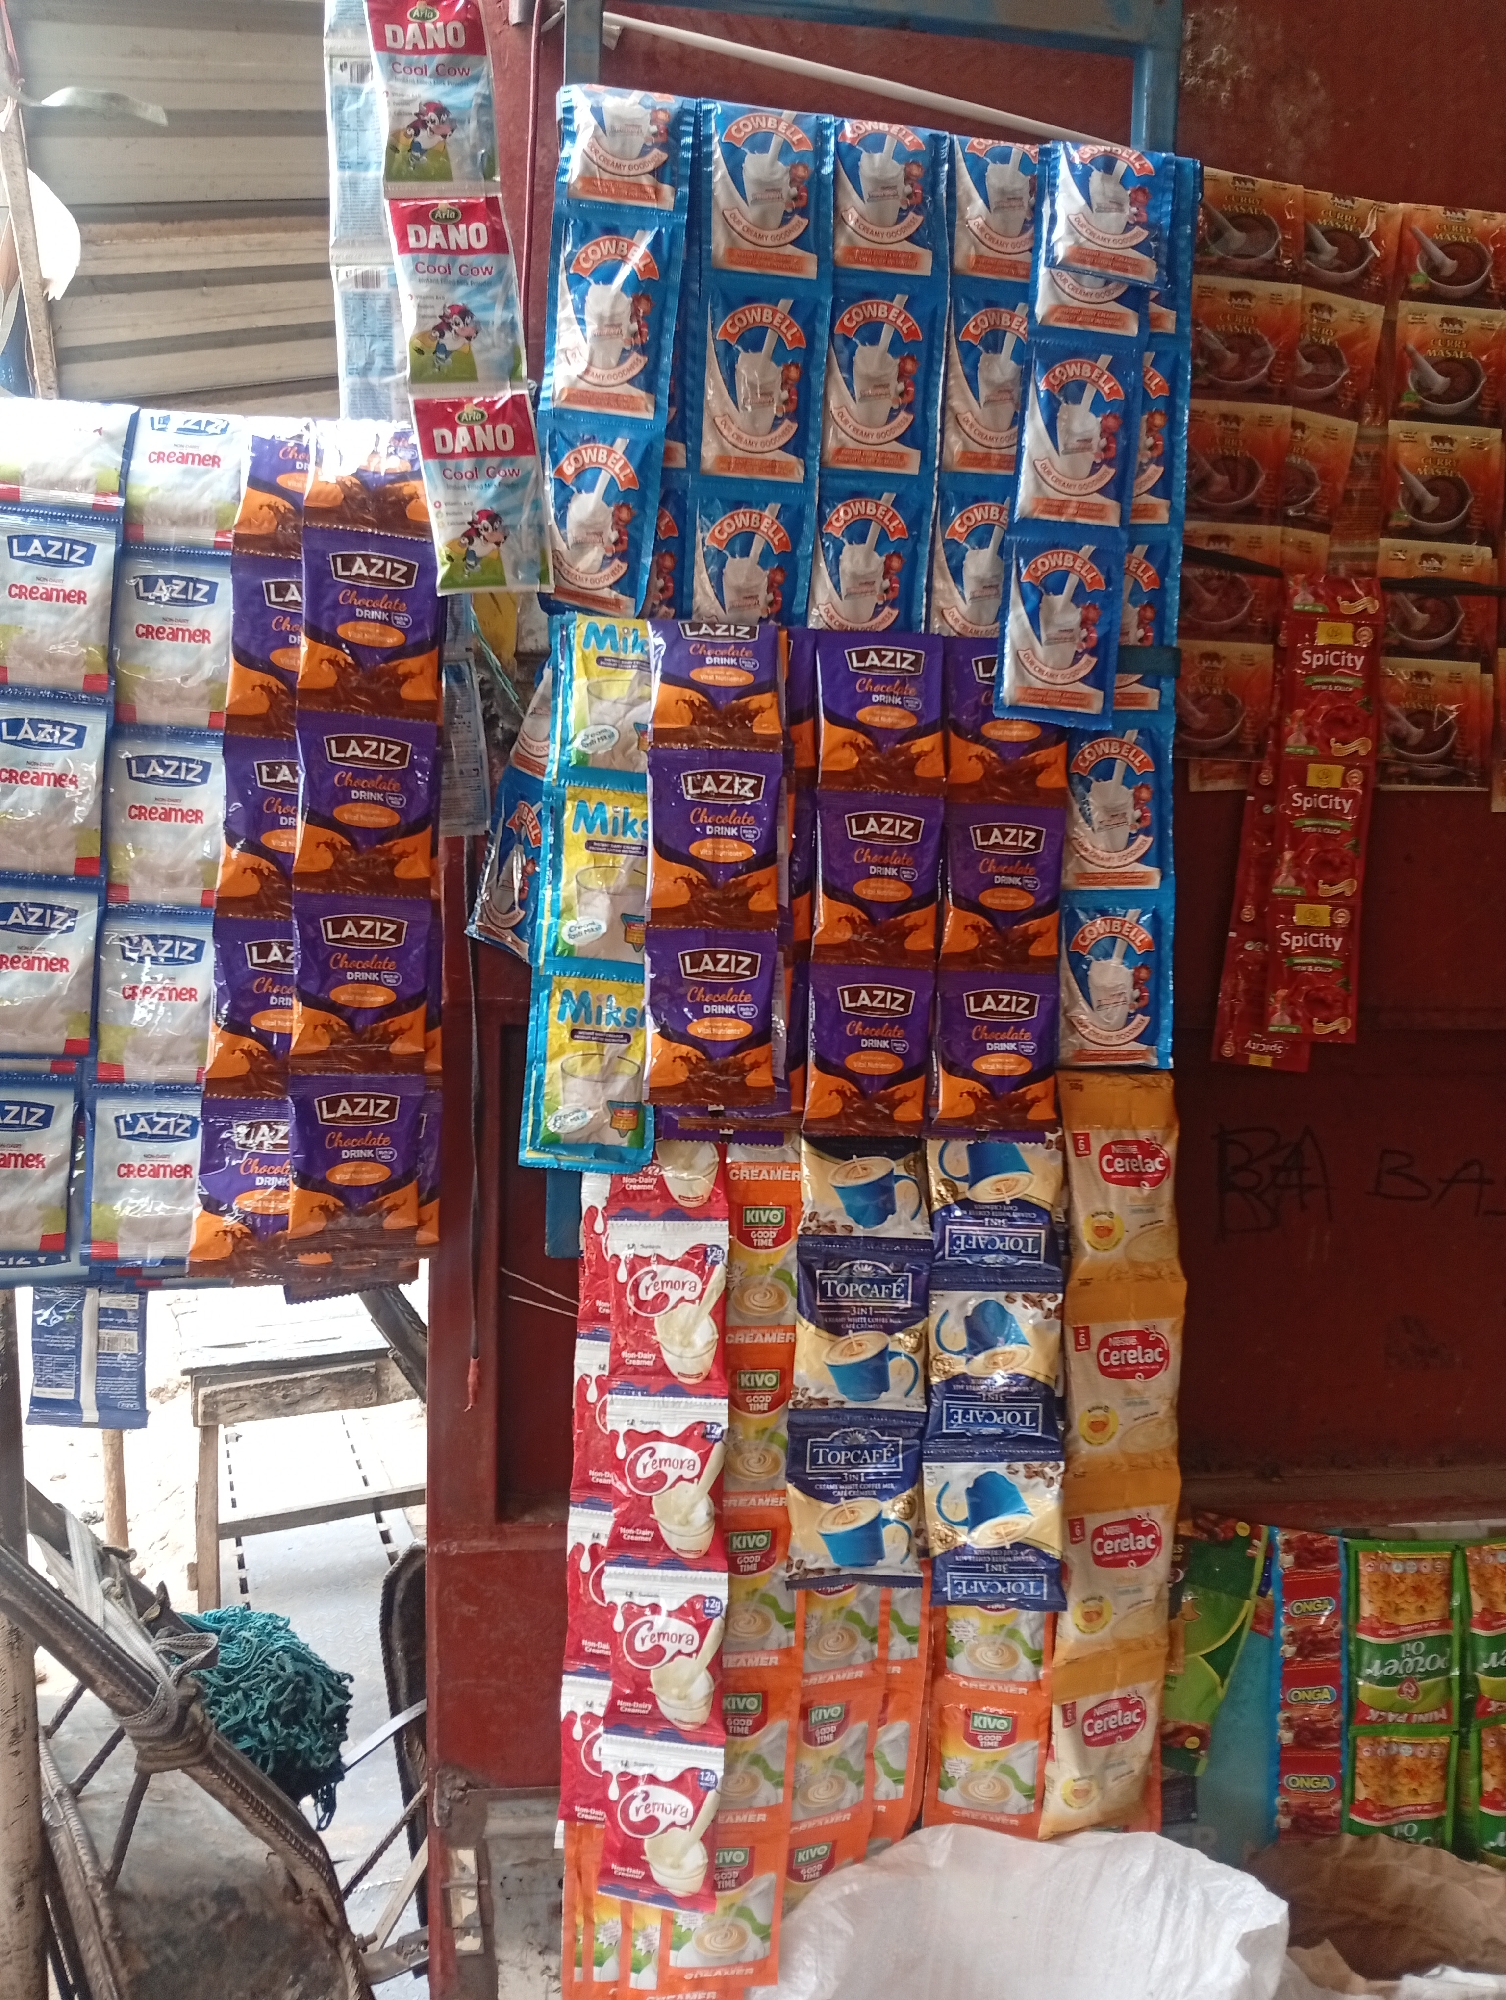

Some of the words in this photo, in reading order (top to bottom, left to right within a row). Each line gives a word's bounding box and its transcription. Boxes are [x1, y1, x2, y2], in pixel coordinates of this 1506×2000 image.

[412, 9, 434, 19] Arla
[384, 21, 466, 50] DANO
[391, 61, 428, 77] Cool
[435, 63, 471, 77] Cow
[730, 115, 804, 146] COWBELL
[598, 153, 627, 171] CREAMY
[1224, 196, 1263, 206] CURRY
[434, 210, 456, 220] Arla
[1320, 209, 1360, 224] CURRY
[1317, 217, 1365, 232] MASALA
[1435, 223, 1474, 234] CURRY
[406, 222, 489, 250] DANO
[1431, 232, 1479, 244] MASALA
[414, 261, 451, 275] Cool
[458, 264, 494, 277] Cow
[1056, 271, 1069, 285] OUR
[1068, 283, 1094, 299] CREAMY
[725, 305, 800, 342] COWBELL
[969, 311, 1027, 335] COWBEL
[1215, 324, 1261, 335] MASALA
[1430, 338, 1468, 349] CURRY
[1425, 349, 1474, 360] MASALA
[607, 357, 642, 381] GOODNESS
[1048, 363, 1116, 394] COWBELL
[461, 412, 482, 422] Arla
[837, 411, 849, 427] OUR
[876, 416, 909, 439] GOODNESS
[432, 424, 515, 454] DANO
[731, 432, 759, 449] CREAMY
[761, 424, 793, 449] GOODNESS
[563, 449, 631, 482] COWBELL
[1420, 456, 1460, 467] CURRY
[442, 467, 479, 481] Cool
[486, 466, 521, 479] Cow
[1417, 465, 1463, 477] MASALA
[1050, 475, 1078, 491] CREAMY
[831, 501, 899, 534] COWBELL
[954, 506, 1009, 534] COWBE
[714, 511, 785, 546] COWBELL
[12, 538, 88, 564] LAZIZ
[336, 557, 409, 584] LAZIZ
[1029, 552, 1097, 584] COWBELL
[36, 576, 64, 584] NON-DAIRY
[338, 589, 408, 611] Chocolate
[356, 608, 389, 622] DRINK
[684, 621, 750, 640] LAZIZ
[689, 644, 753, 658] Chocolate
[705, 657, 738, 666] DRINK
[851, 652, 916, 671] LAZIZ
[1023, 654, 1035, 667] OUR
[1301, 649, 1365, 670] SpiCity
[856, 678, 917, 695] Chocolate
[872, 694, 902, 705] DRINK
[1, 720, 78, 747] LAZIZ
[1077, 742, 1147, 767] COWBELL
[26, 760, 55, 768] NON-DAIRY
[131, 759, 203, 783] LAZIZ
[333, 770, 401, 793] Chocolate
[351, 790, 384, 802] DRINK
[1291, 792, 1353, 813] SpiCity
[572, 799, 649, 840] Miks
[689, 808, 756, 825] Chocolate
[851, 817, 916, 838] LAZIZ
[976, 829, 1036, 850] LAZIZ
[853, 848, 914, 866] Chocolate
[994, 876, 1022, 886] DRINK
[327, 920, 397, 943] LAZIZ
[1077, 920, 1147, 947] COWBELL
[1279, 931, 1343, 951] SpiCity
[329, 951, 397, 971] Chocolate
[684, 955, 752, 975] LAZIZ
[346, 971, 379, 982] DRINK
[703, 1004, 735, 1015] DRINK
[968, 995, 1031, 1015] LAZIZ
[696, 1027, 711, 1035] Vital
[712, 1027, 744, 1036] Nutrients
[846, 1020, 905, 1037] Chocolate
[972, 1025, 1033, 1041] Chocolate
[861, 1038, 889, 1049] DRINK
[986, 1042, 1017, 1051] DRINK
[1244, 1039, 1285, 1055] SpiCity
[322, 1097, 391, 1120] LAZIZ
[119, 1117, 192, 1137] LAZIZ
[325, 1131, 391, 1150] Chocolate
[1077, 1140, 1085, 1150] 6
[342, 1149, 374, 1160] DRINK
[1101, 1155, 1166, 1173] Cerelac
[622, 1176, 657, 1186] Non-Dairy
[729, 1169, 801, 1182] CREAMER
[625, 1183, 656, 1191] Creamer
[745, 1209, 782, 1224] KIVO
[750, 1229, 778, 1240] GOOD
[753, 1238, 774, 1247] TIME
[953, 1234, 1039, 1256] TOPCAFÉ
[628, 1269, 697, 1316] Cremora
[822, 1277, 904, 1299] TOPCAFÉ
[850, 1307, 873, 1316] 3IN1
[726, 1332, 795, 1344] CREAMER
[1078, 1333, 1086, 1345] 6
[621, 1351, 656, 1361] Non-Dairy
[625, 1357, 655, 1367] Creamer
[1099, 1346, 1164, 1366] Cerelac
[740, 1374, 777, 1387] KIVO
[746, 1396, 772, 1404] GOOD
[749, 1403, 769, 1411] TIME
[950, 1408, 1036, 1428] TOPCAFÉ
[813, 1445, 895, 1466] TOPCAFÉ
[627, 1445, 696, 1495] Cremora
[842, 1473, 866, 1482] 3IN1
[623, 1534, 653, 1542] Creamer
[1074, 1525, 1082, 1538] 6
[731, 1535, 769, 1549] KIVO
[1092, 1534, 1156, 1557] Cerelac
[736, 1555, 761, 1565] GOOD
[740, 1563, 758, 1571] TIME
[985, 1563, 1009, 1573] 3IN1
[954, 1581, 1042, 1601] TOPCAFÉ
[705, 1599, 721, 1610] 12g
[1292, 1601, 1331, 1613] ONGA
[625, 1620, 695, 1669] Cremora
[1402, 1641, 1425, 1657] Oil
[1366, 1649, 1449, 1676] Power
[802, 1670, 864, 1687] CREAMER
[959, 1681, 1029, 1695] CREAMER
[1290, 1688, 1332, 1701] ONGA
[617, 1700, 652, 1710] Non-Dairy
[619, 1707, 649, 1715] Creamer
[811, 1706, 841, 1722] KIVO
[1066, 1708, 1073, 1722] 6
[1369, 1708, 1410, 1722] PACK
[1412, 1708, 1447, 1722] MINI
[974, 1715, 1009, 1730] KIVO
[1083, 1709, 1142, 1738] Cerelac
[815, 1726, 837, 1736] GOOD
[699, 1772, 716, 1783] 12g
[1288, 1776, 1331, 1790] ONGA
[619, 1790, 690, 1838] Cremora
[797, 1845, 828, 1863] KIVO
[611, 1863, 646, 1874] Non-Dairy
[614, 1871, 645, 1880] Creamer
[801, 1863, 823, 1875] GOOD
[803, 1872, 820, 1881] TIME
